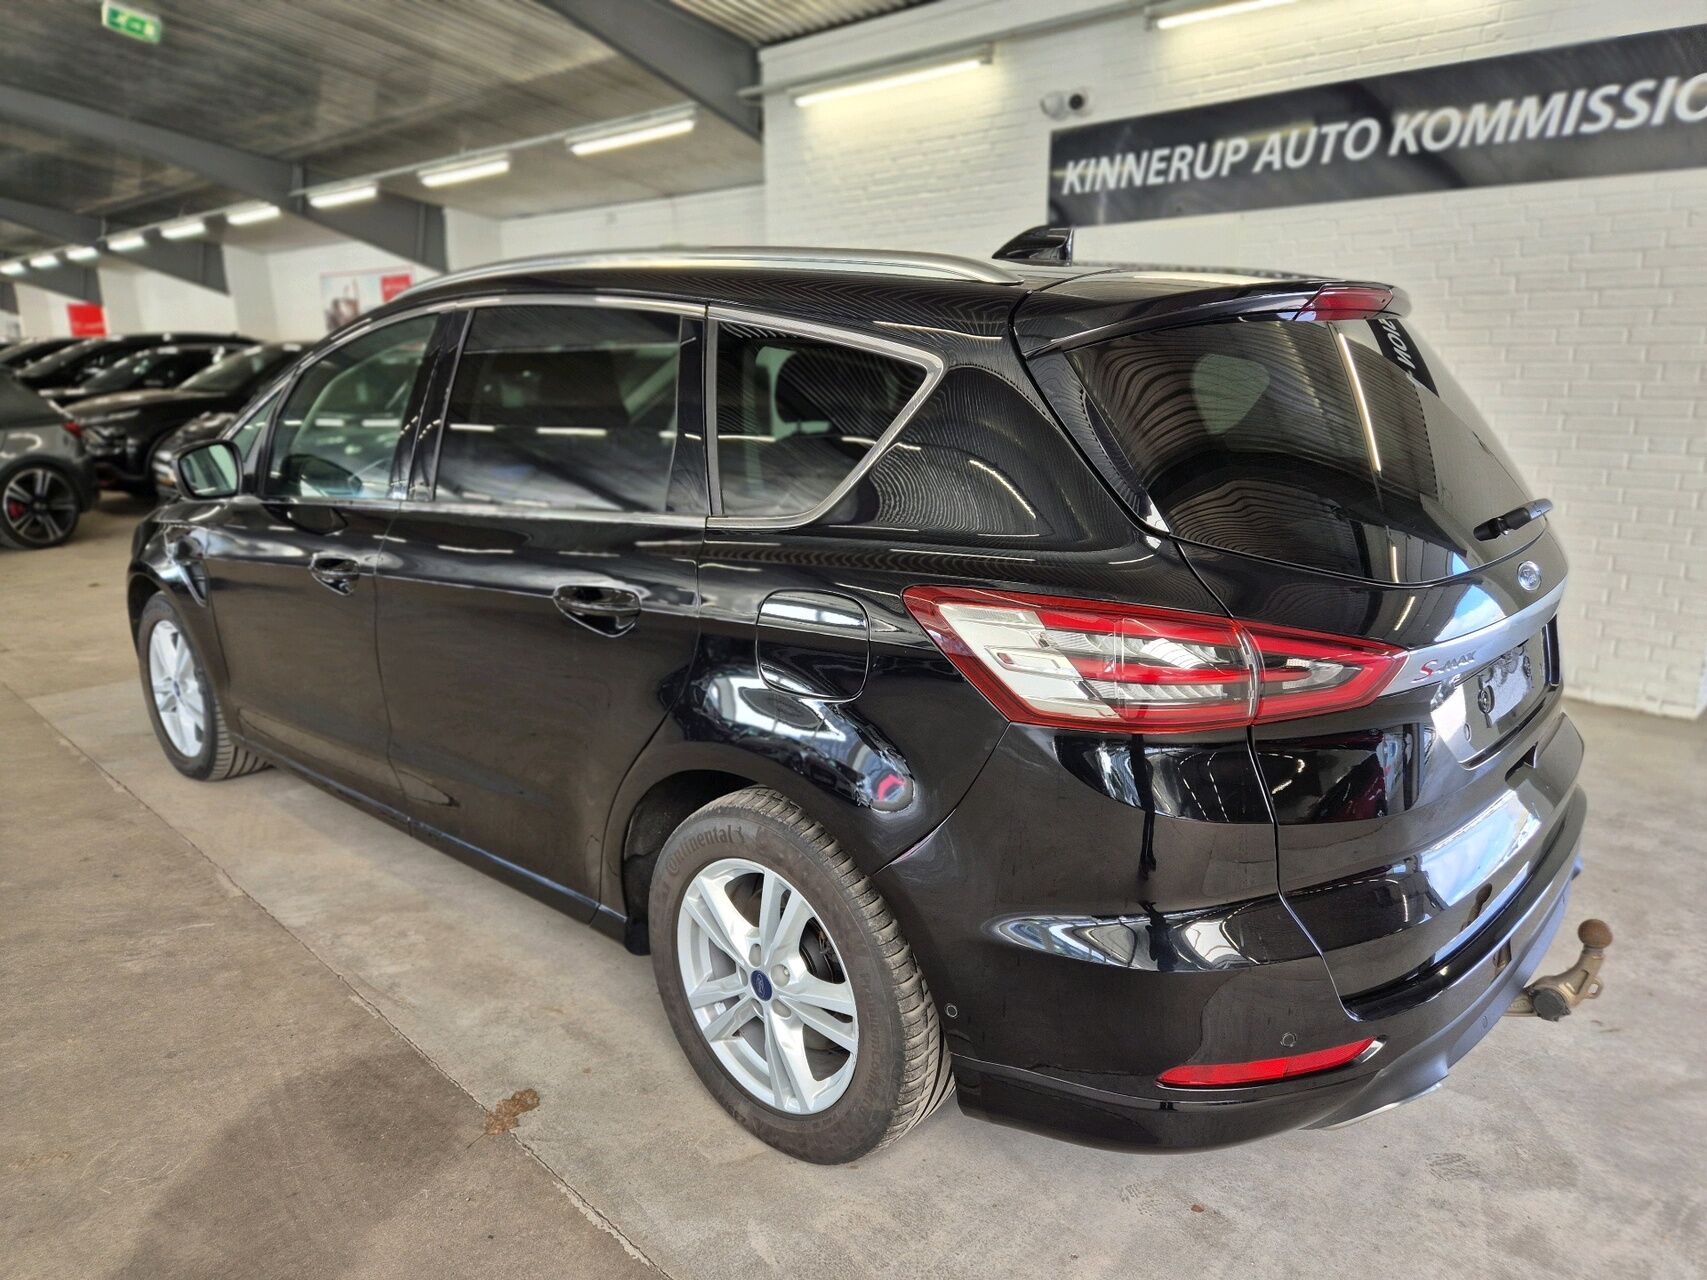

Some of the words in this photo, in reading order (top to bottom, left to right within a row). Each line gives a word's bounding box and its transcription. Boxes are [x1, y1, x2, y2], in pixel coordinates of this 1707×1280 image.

[1062, 138, 1249, 195] KINNERUP
[1252, 118, 1381, 173] AUTO
[1388, 72, 1707, 157] KOMMISSIO
[667, 824, 735, 876] Continental
